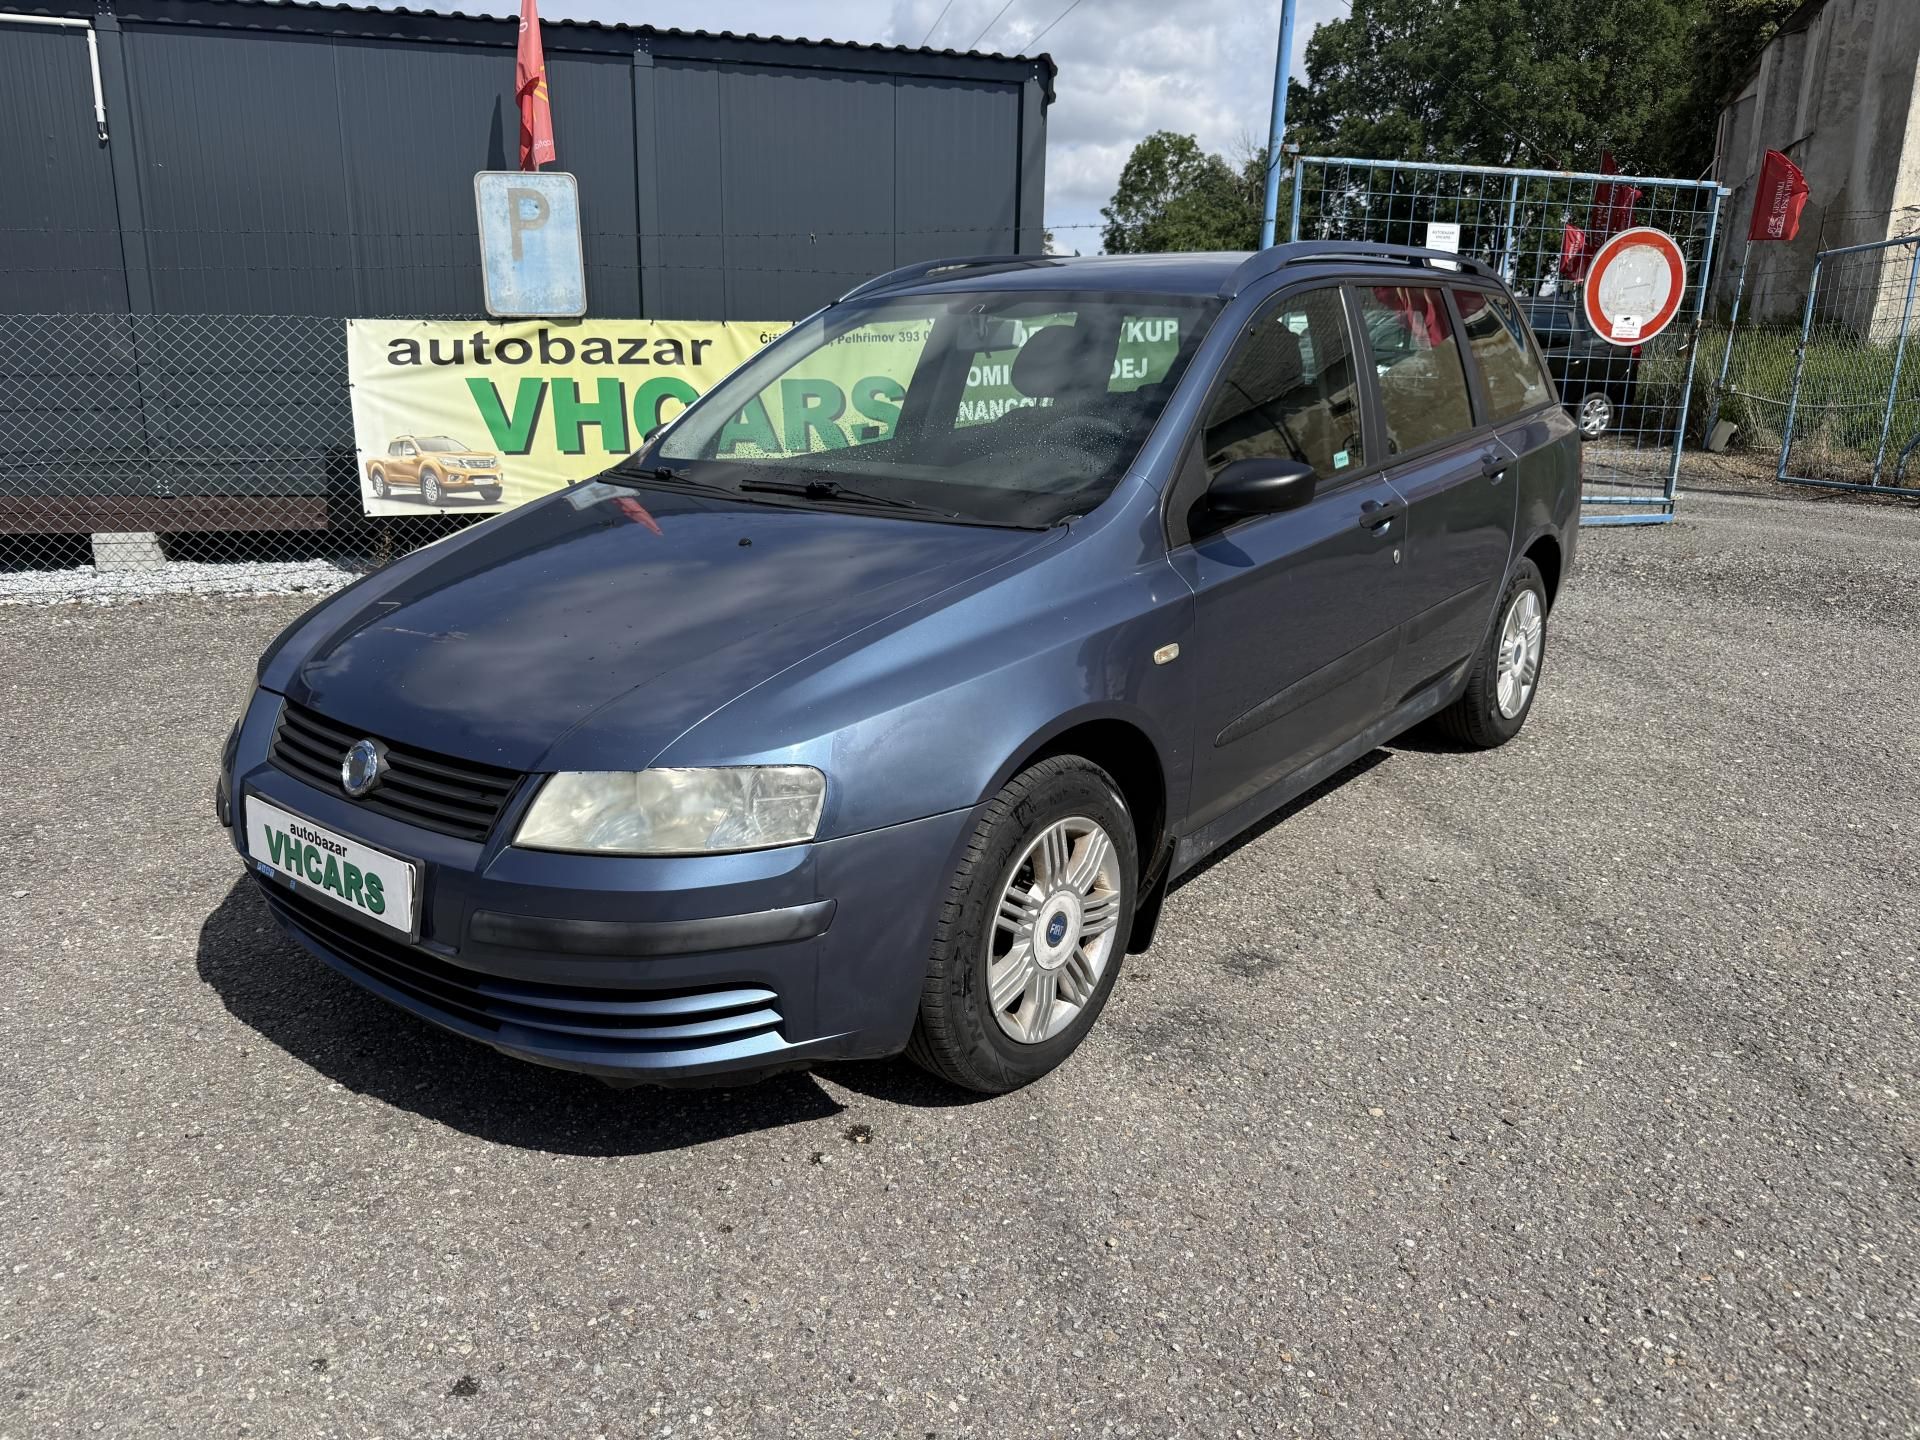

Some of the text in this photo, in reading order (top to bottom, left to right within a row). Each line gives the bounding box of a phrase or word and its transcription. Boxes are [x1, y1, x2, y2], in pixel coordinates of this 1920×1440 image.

[507, 187, 550, 262] P
[899, 331, 920, 343] 393
[1119, 320, 1178, 343] KUP
[387, 328, 713, 366] autobazar
[966, 365, 1010, 387] OMI
[290, 823, 348, 858] autobazar
[264, 823, 386, 915] VHCARS
[1050, 923, 1065, 936] FIAT
